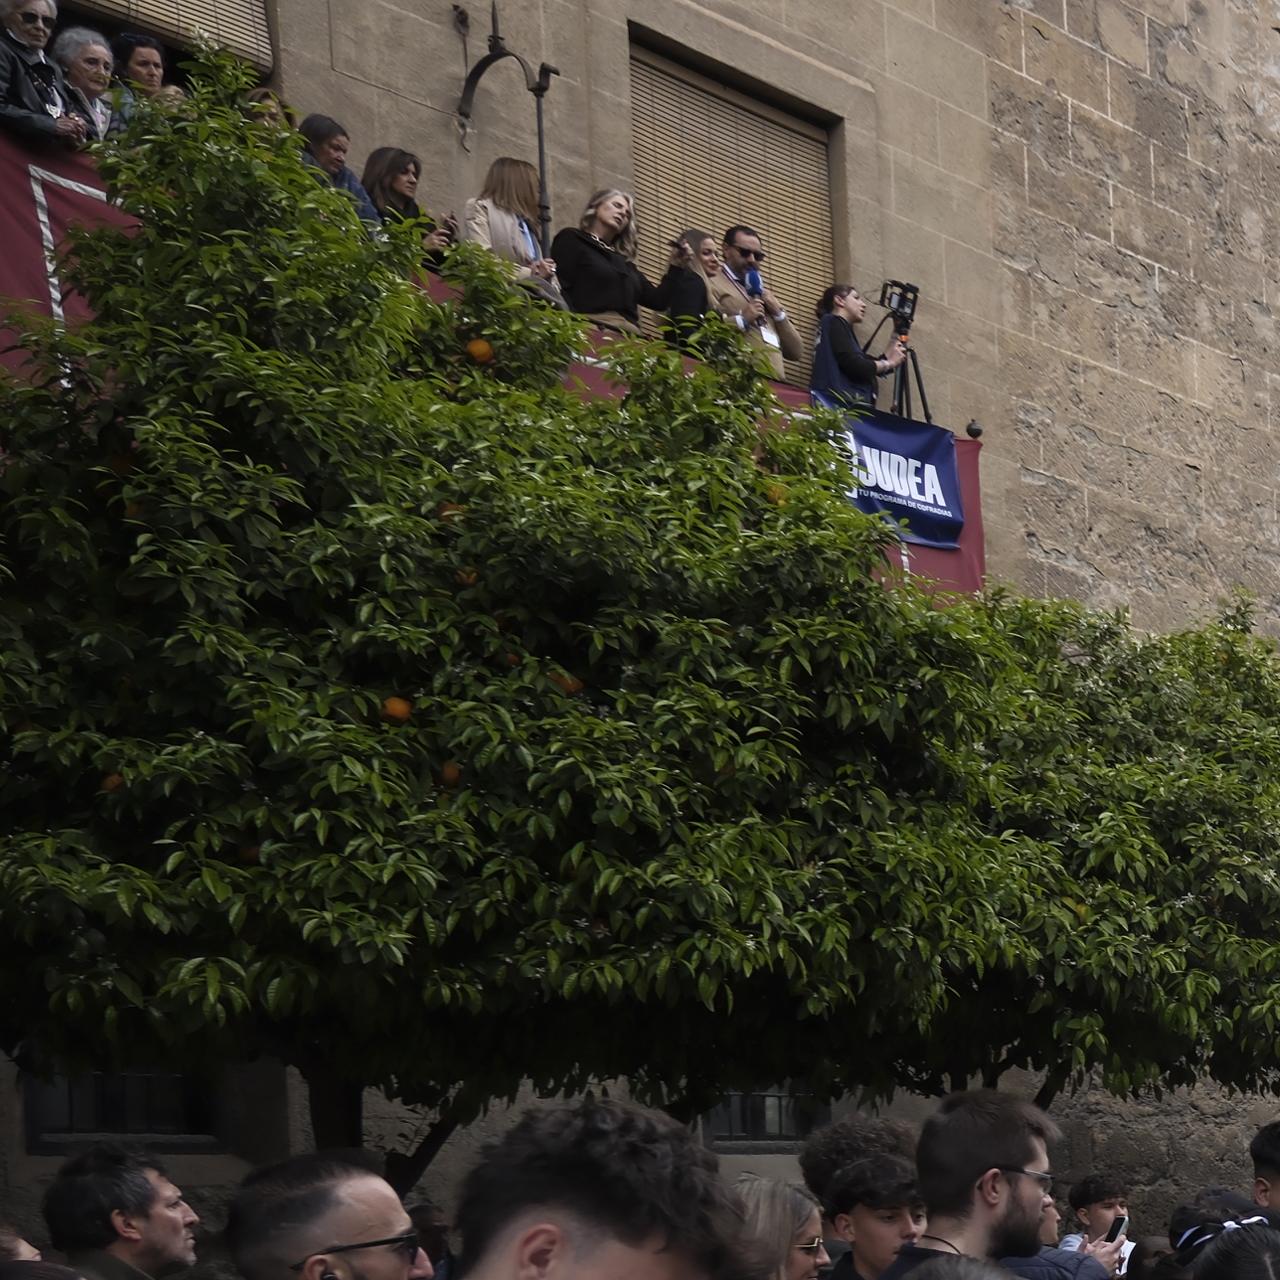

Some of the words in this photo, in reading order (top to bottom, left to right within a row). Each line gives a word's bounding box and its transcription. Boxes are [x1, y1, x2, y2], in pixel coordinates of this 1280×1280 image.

[860, 445, 946, 507] JUDEA
[870, 491, 907, 506] PROGRAMA
[907, 500, 917, 509] DE
